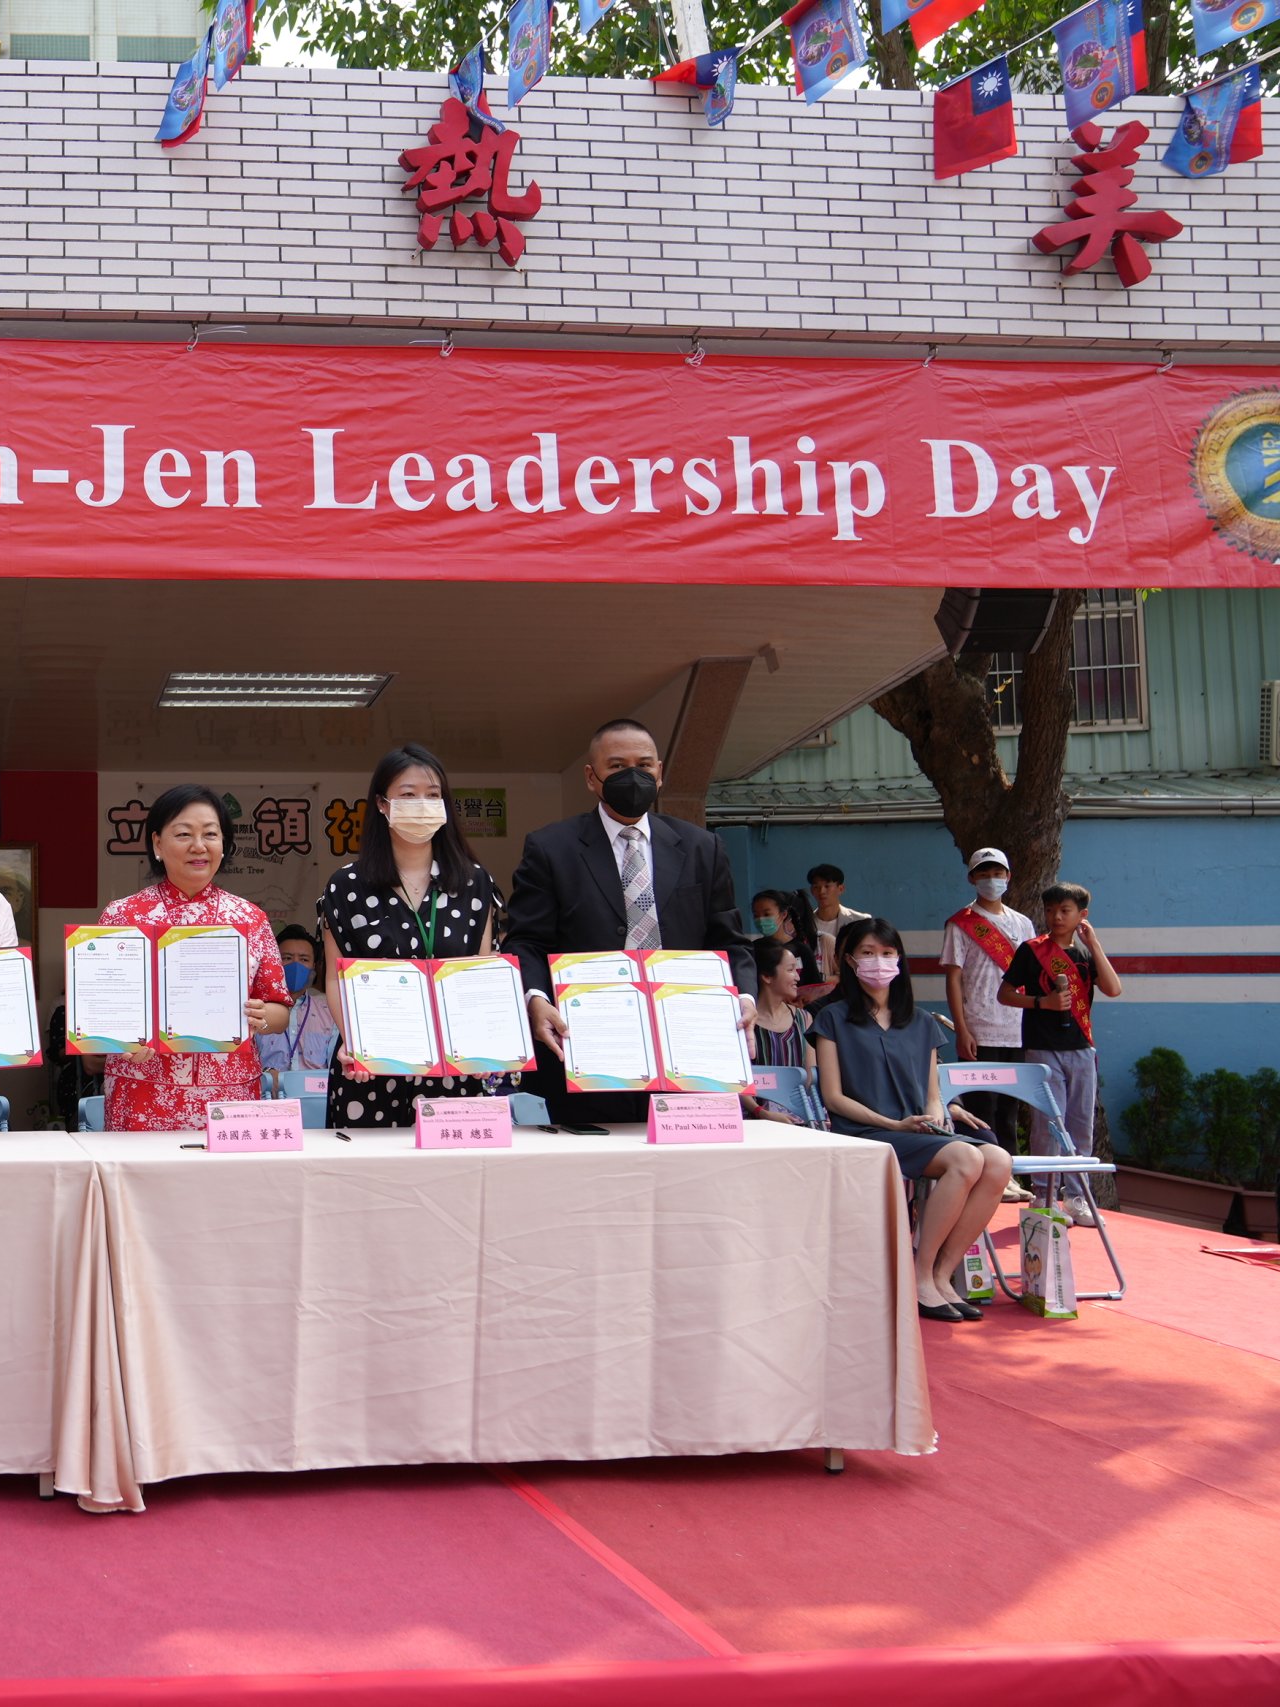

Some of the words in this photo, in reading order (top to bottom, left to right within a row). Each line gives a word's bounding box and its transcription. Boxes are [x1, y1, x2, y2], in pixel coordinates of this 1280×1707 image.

[399, 97, 542, 266] 熱
[302, 428, 886, 541] Leadership
[921, 439, 1117, 545] Day
[470, 1128, 494, 1139] 總監
[661, 1123, 674, 1131] Mr.
[675, 1123, 690, 1131] Paul
[217, 1129, 252, 1141] 孫國燕
[259, 1128, 294, 1140] 董事長
